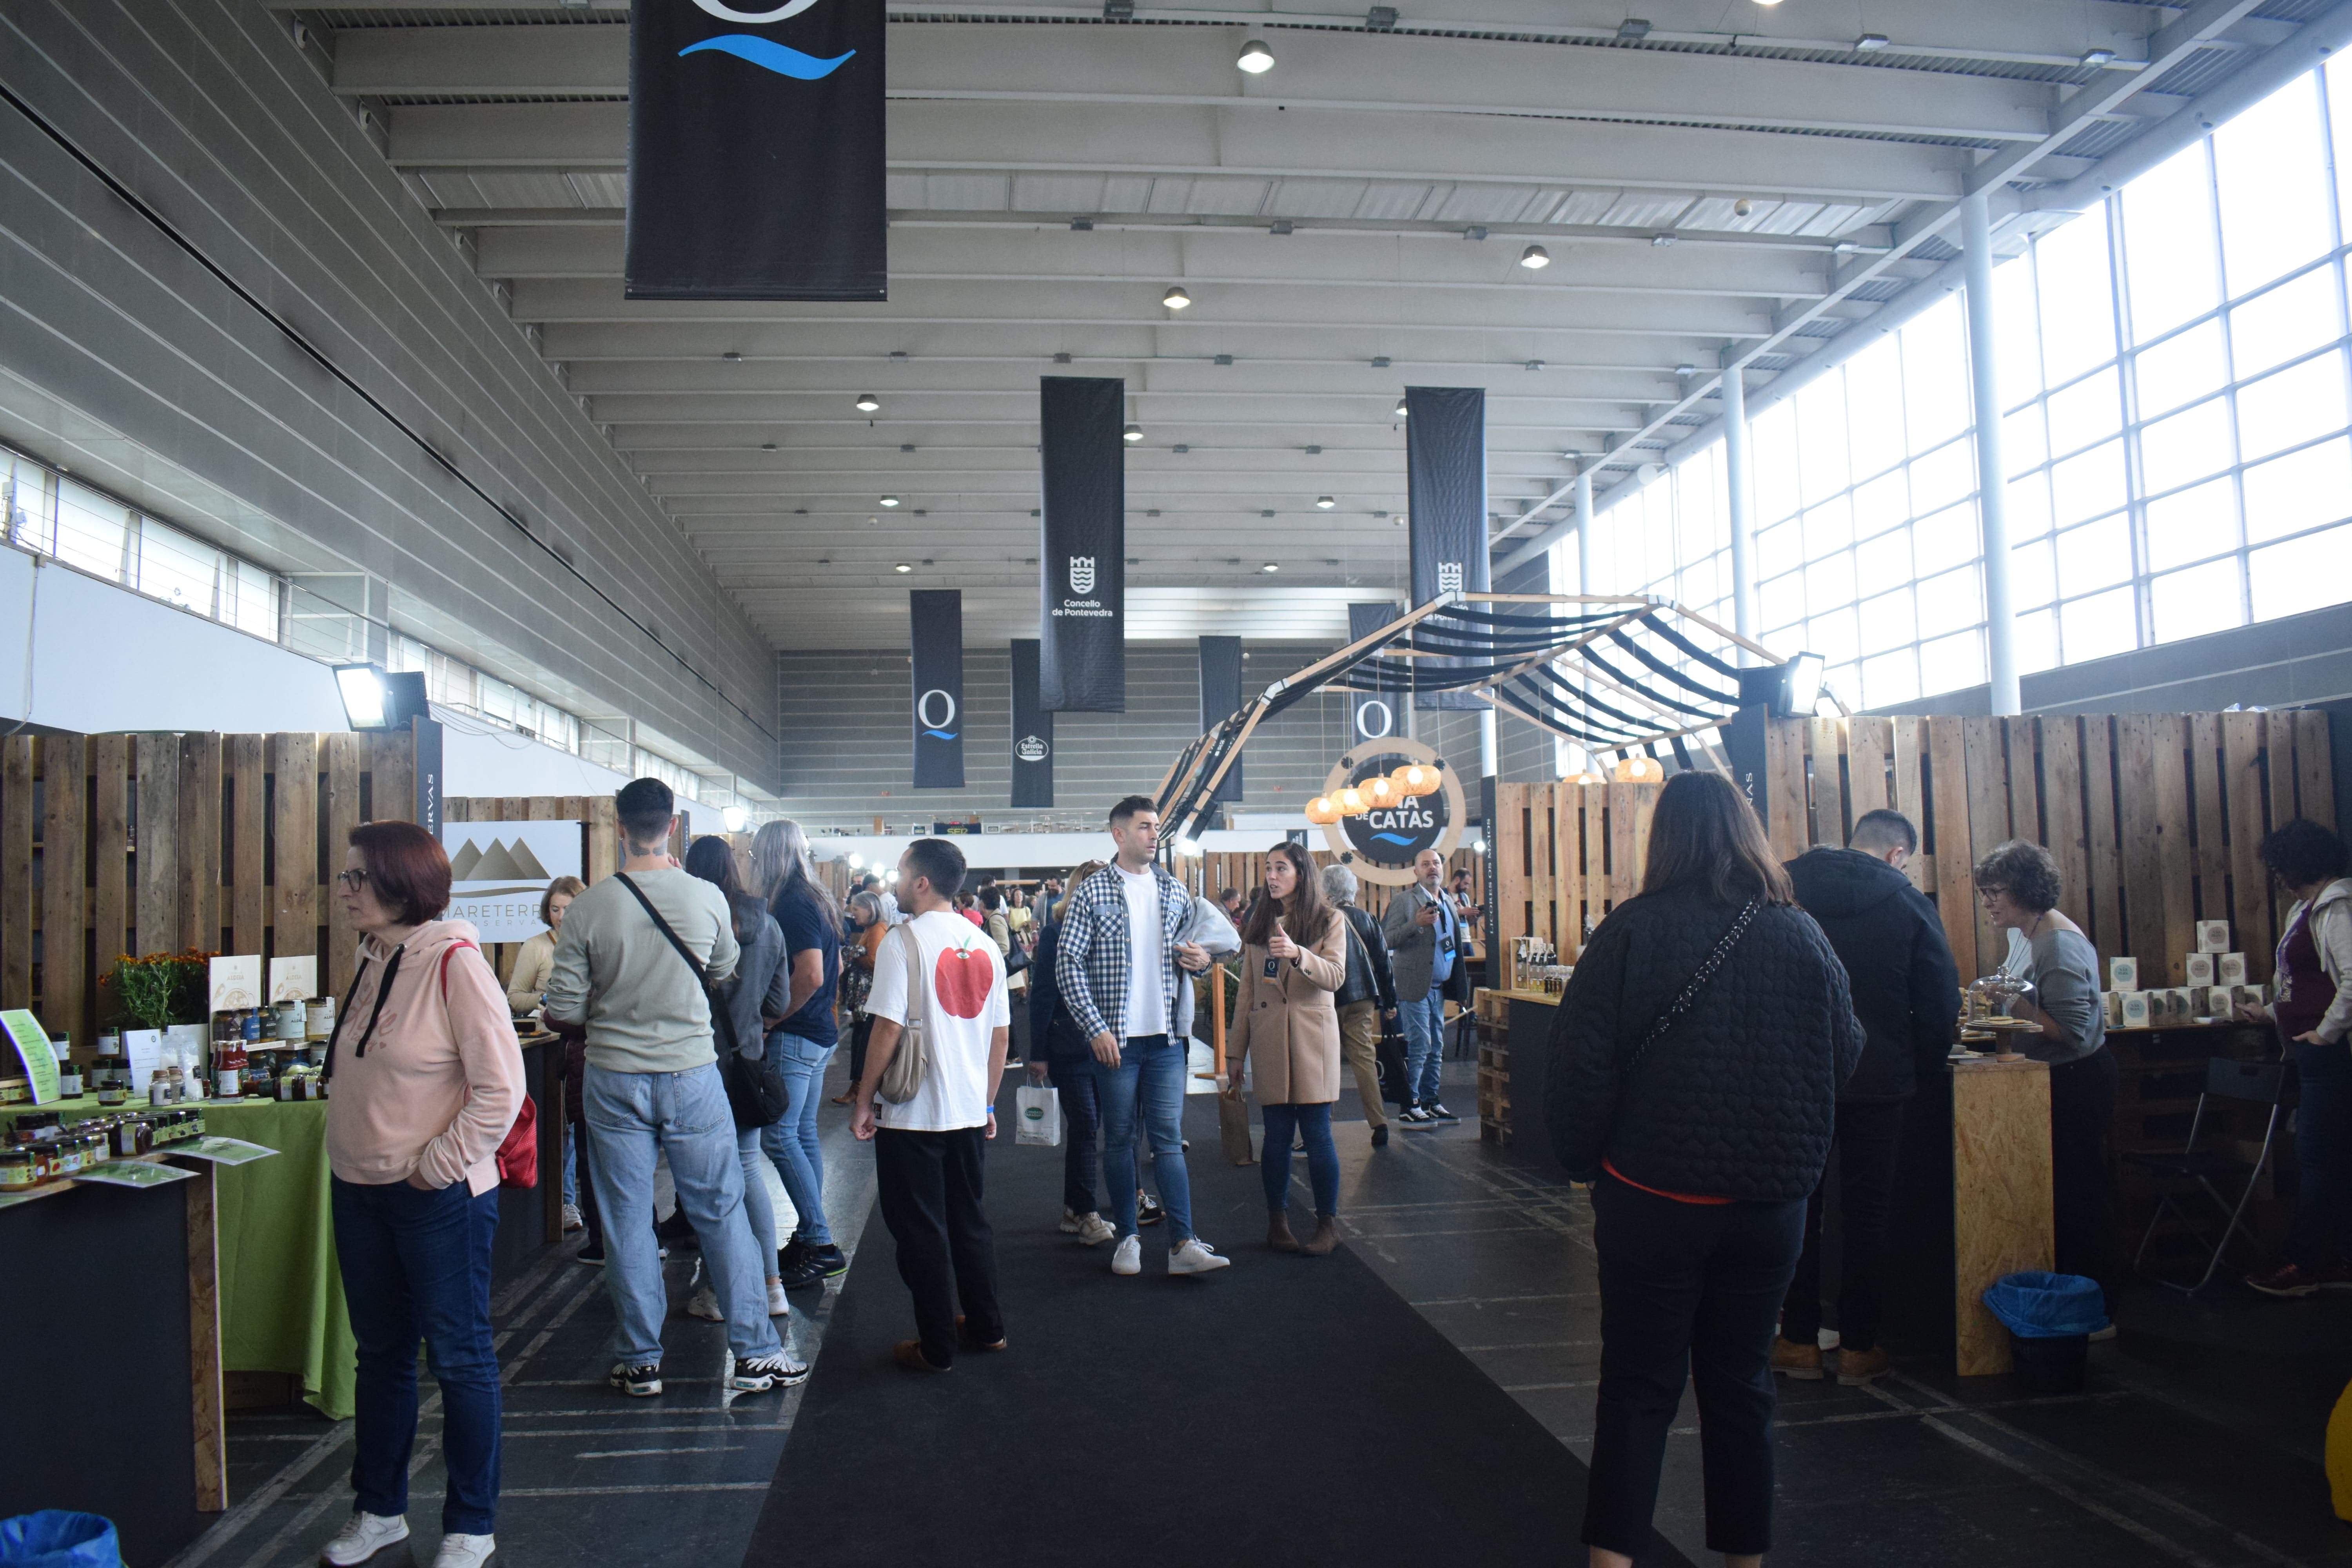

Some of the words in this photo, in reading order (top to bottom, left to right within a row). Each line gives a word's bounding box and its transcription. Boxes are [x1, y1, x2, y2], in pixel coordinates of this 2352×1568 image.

[1369, 810, 1434, 829] CATAS
[1488, 862, 1492, 878] OS
[442, 904, 541, 918] MARETERR
